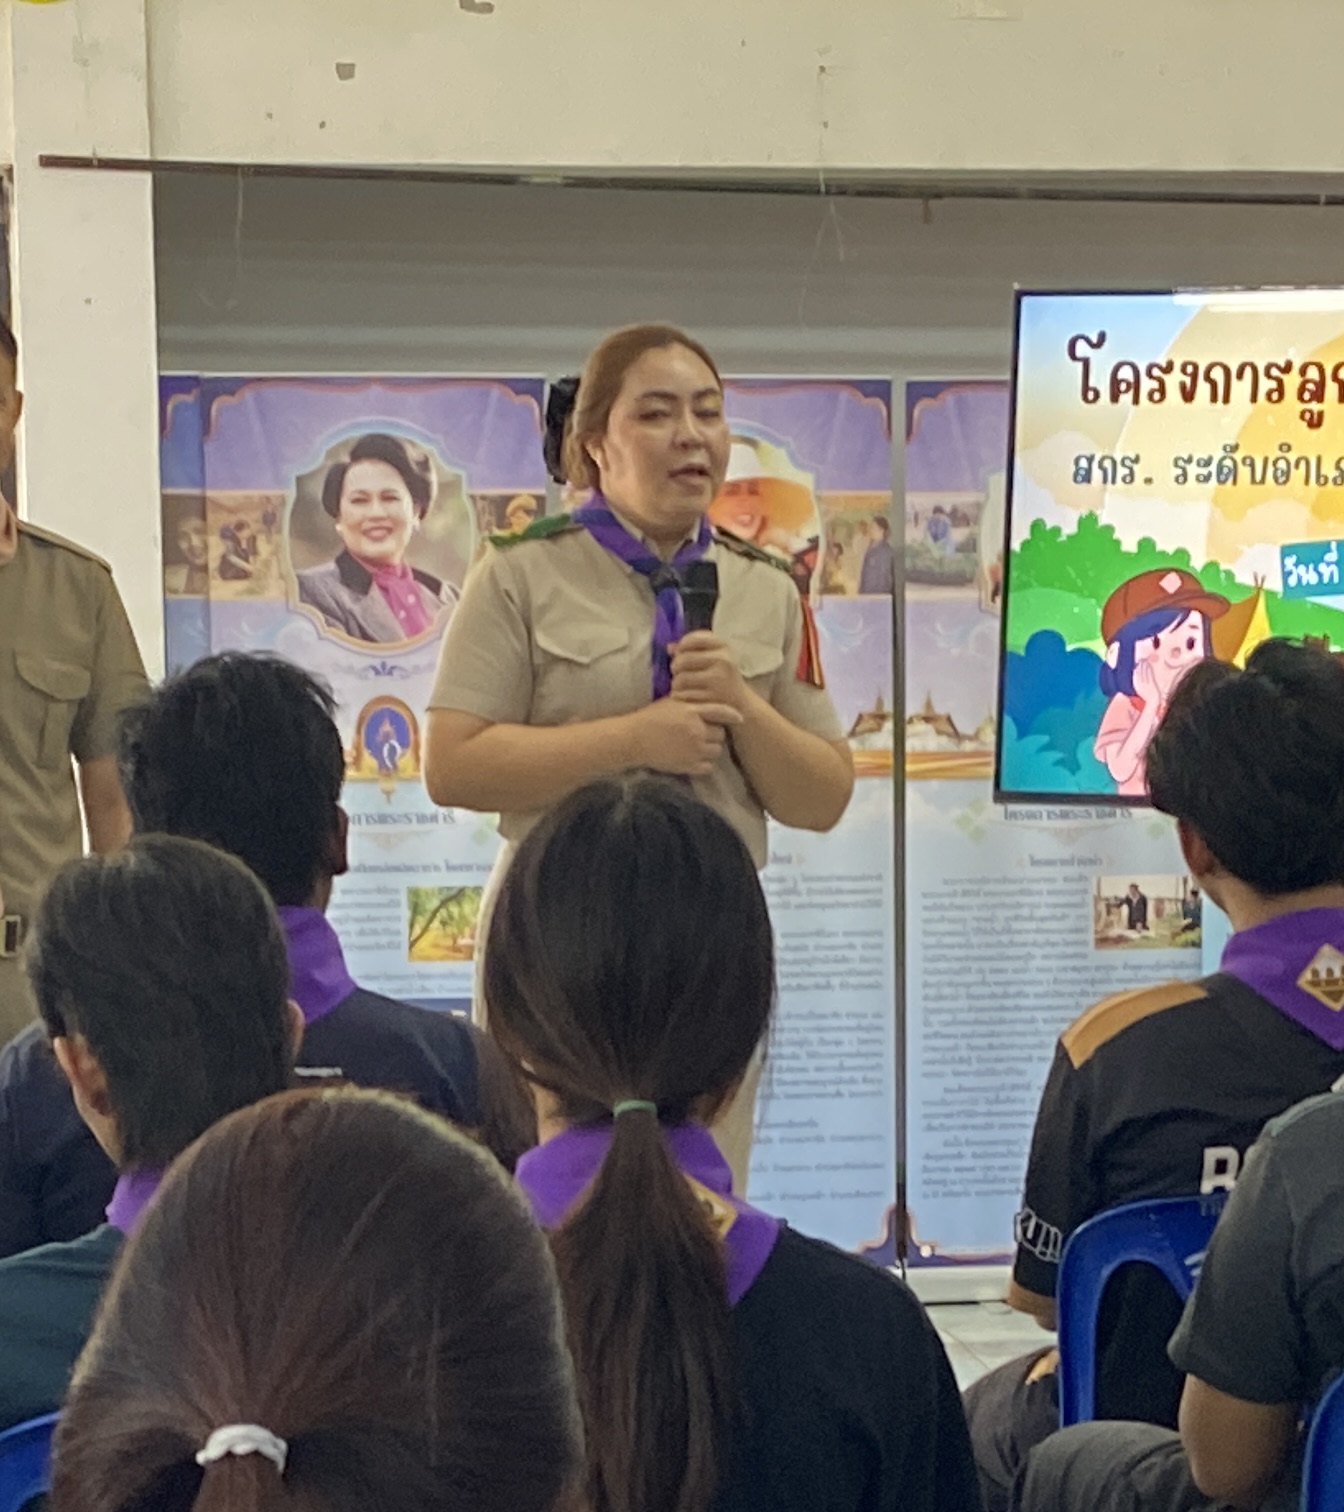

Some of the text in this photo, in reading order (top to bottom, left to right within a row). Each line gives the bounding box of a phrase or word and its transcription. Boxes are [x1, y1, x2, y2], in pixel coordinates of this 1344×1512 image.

[1072, 450, 1154, 488] สกร.
[1283, 541, 1340, 588] วันที่
